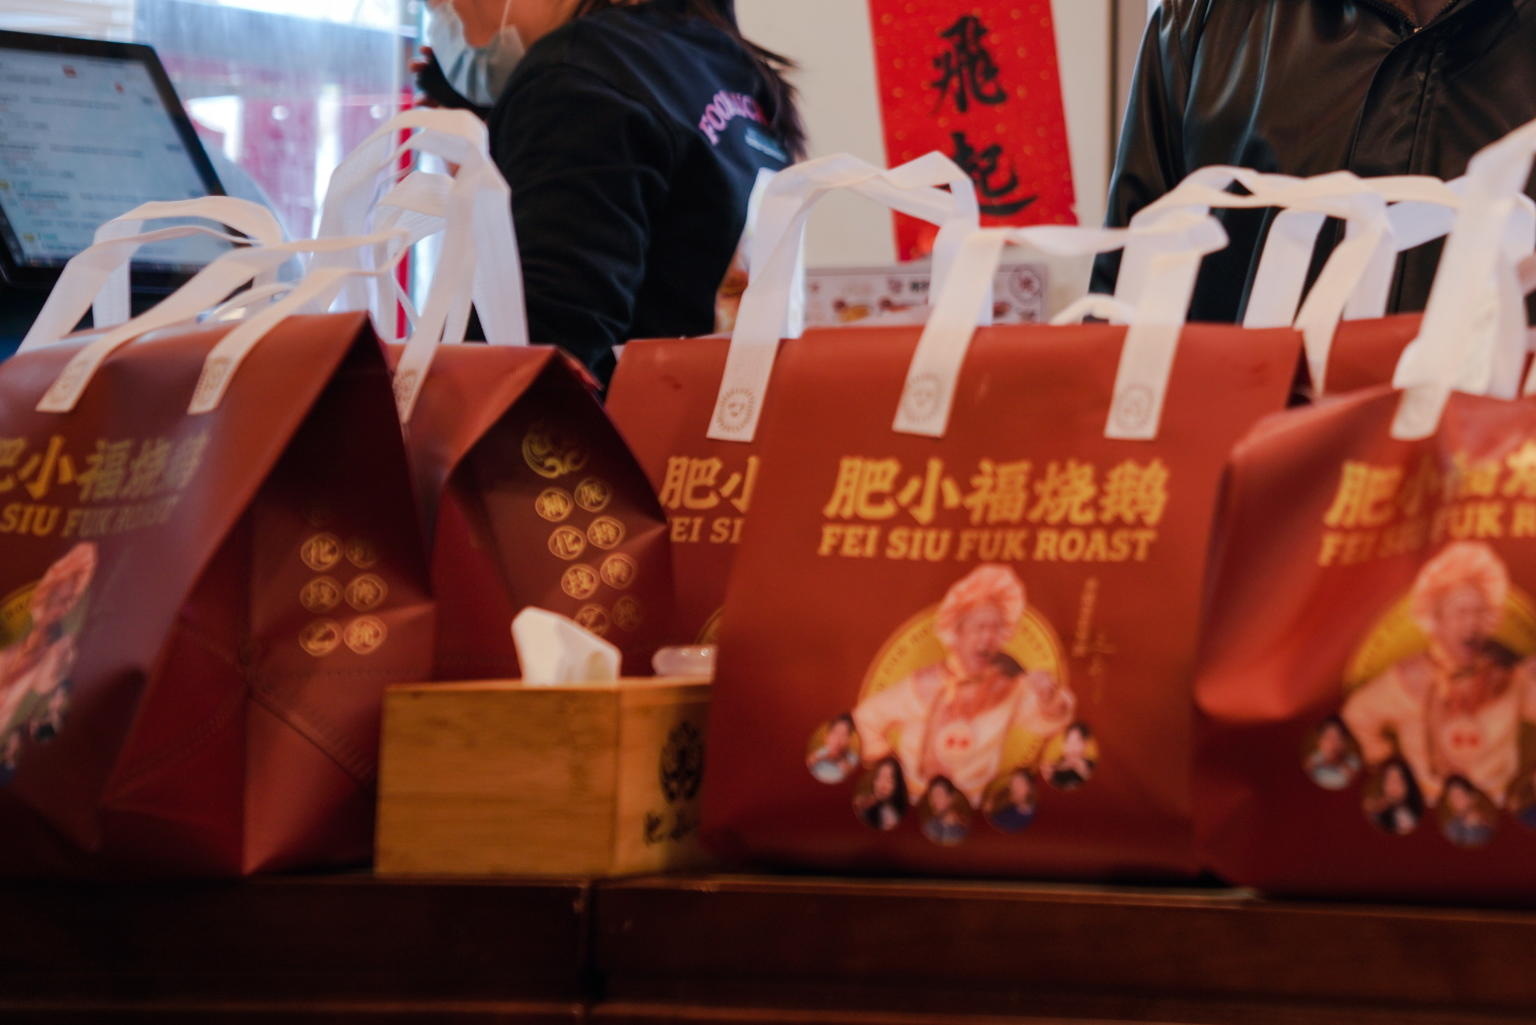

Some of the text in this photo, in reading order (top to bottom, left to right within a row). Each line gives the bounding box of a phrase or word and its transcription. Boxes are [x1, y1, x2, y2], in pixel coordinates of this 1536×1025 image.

[823, 456, 1170, 526] 肥小福烧鹅
[818, 525, 1158, 562] FEI SIU FUK ROAST
